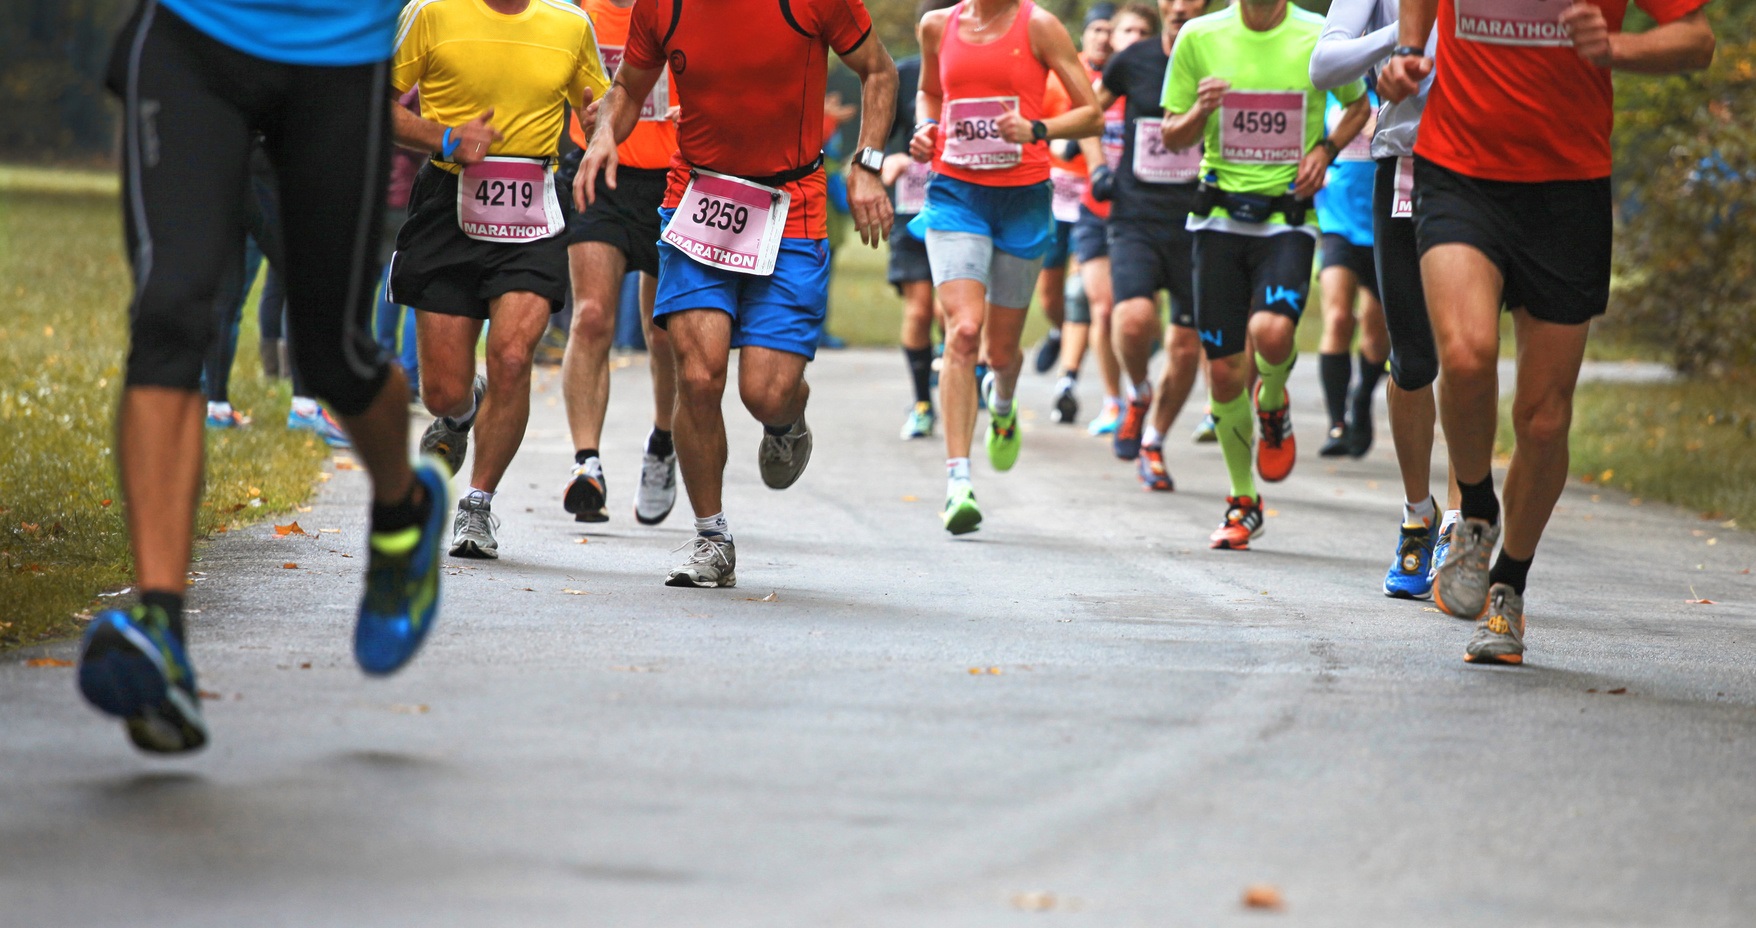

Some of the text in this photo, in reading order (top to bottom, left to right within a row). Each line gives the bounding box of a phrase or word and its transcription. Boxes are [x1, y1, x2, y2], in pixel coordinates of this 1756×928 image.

[1461, 17, 1571, 38] MARATHON
[1233, 111, 1287, 134] 4599
[949, 150, 1020, 165] ARATHON
[1225, 148, 1299, 159] MARATHON
[475, 180, 532, 208] 4219
[692, 197, 749, 234] 3259
[464, 222, 548, 238] MARATHON
[668, 232, 755, 267] MARATHON
